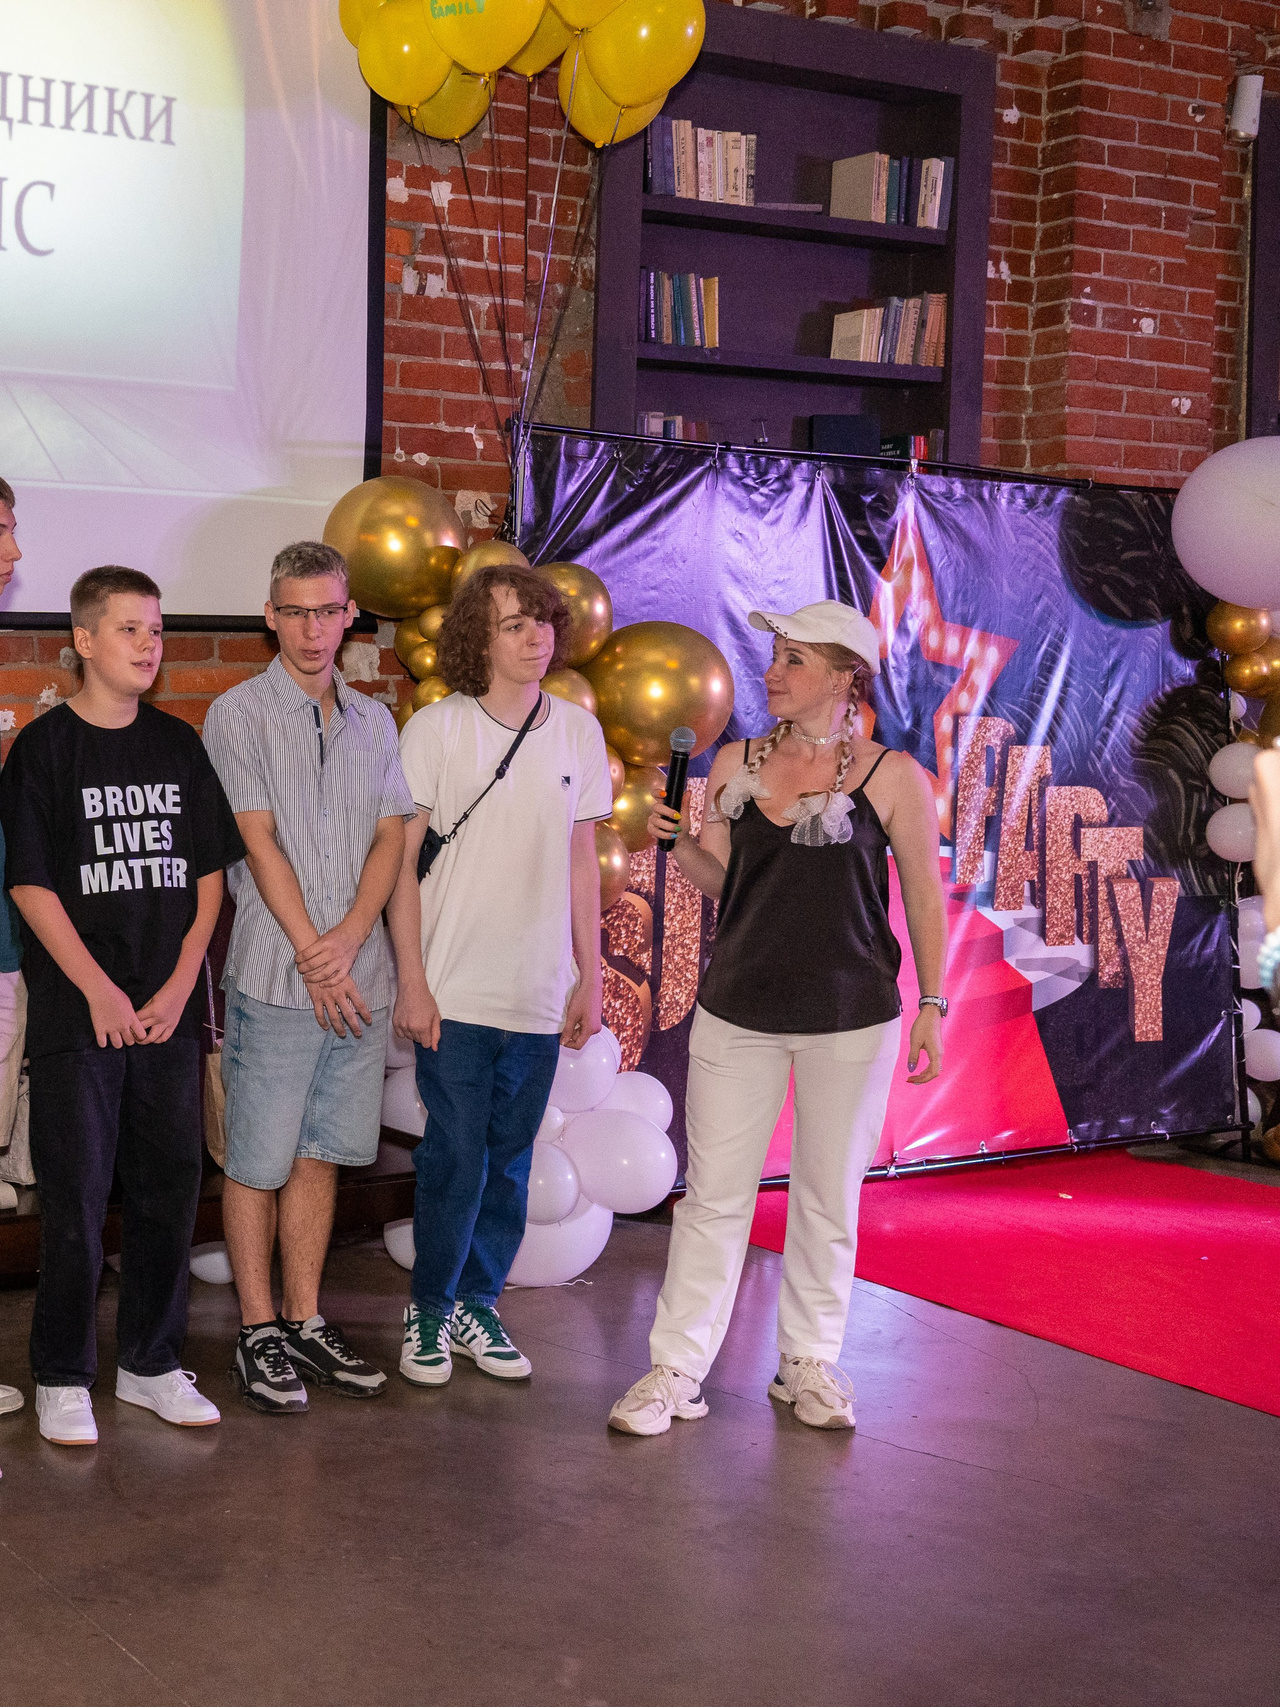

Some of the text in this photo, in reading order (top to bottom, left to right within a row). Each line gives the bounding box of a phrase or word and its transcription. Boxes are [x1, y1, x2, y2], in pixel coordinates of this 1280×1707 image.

[81, 783, 182, 819] BROKE
[94, 819, 173, 856] LIVES
[80, 857, 188, 895] MATTER
[955, 716, 1180, 1042] PARTY
